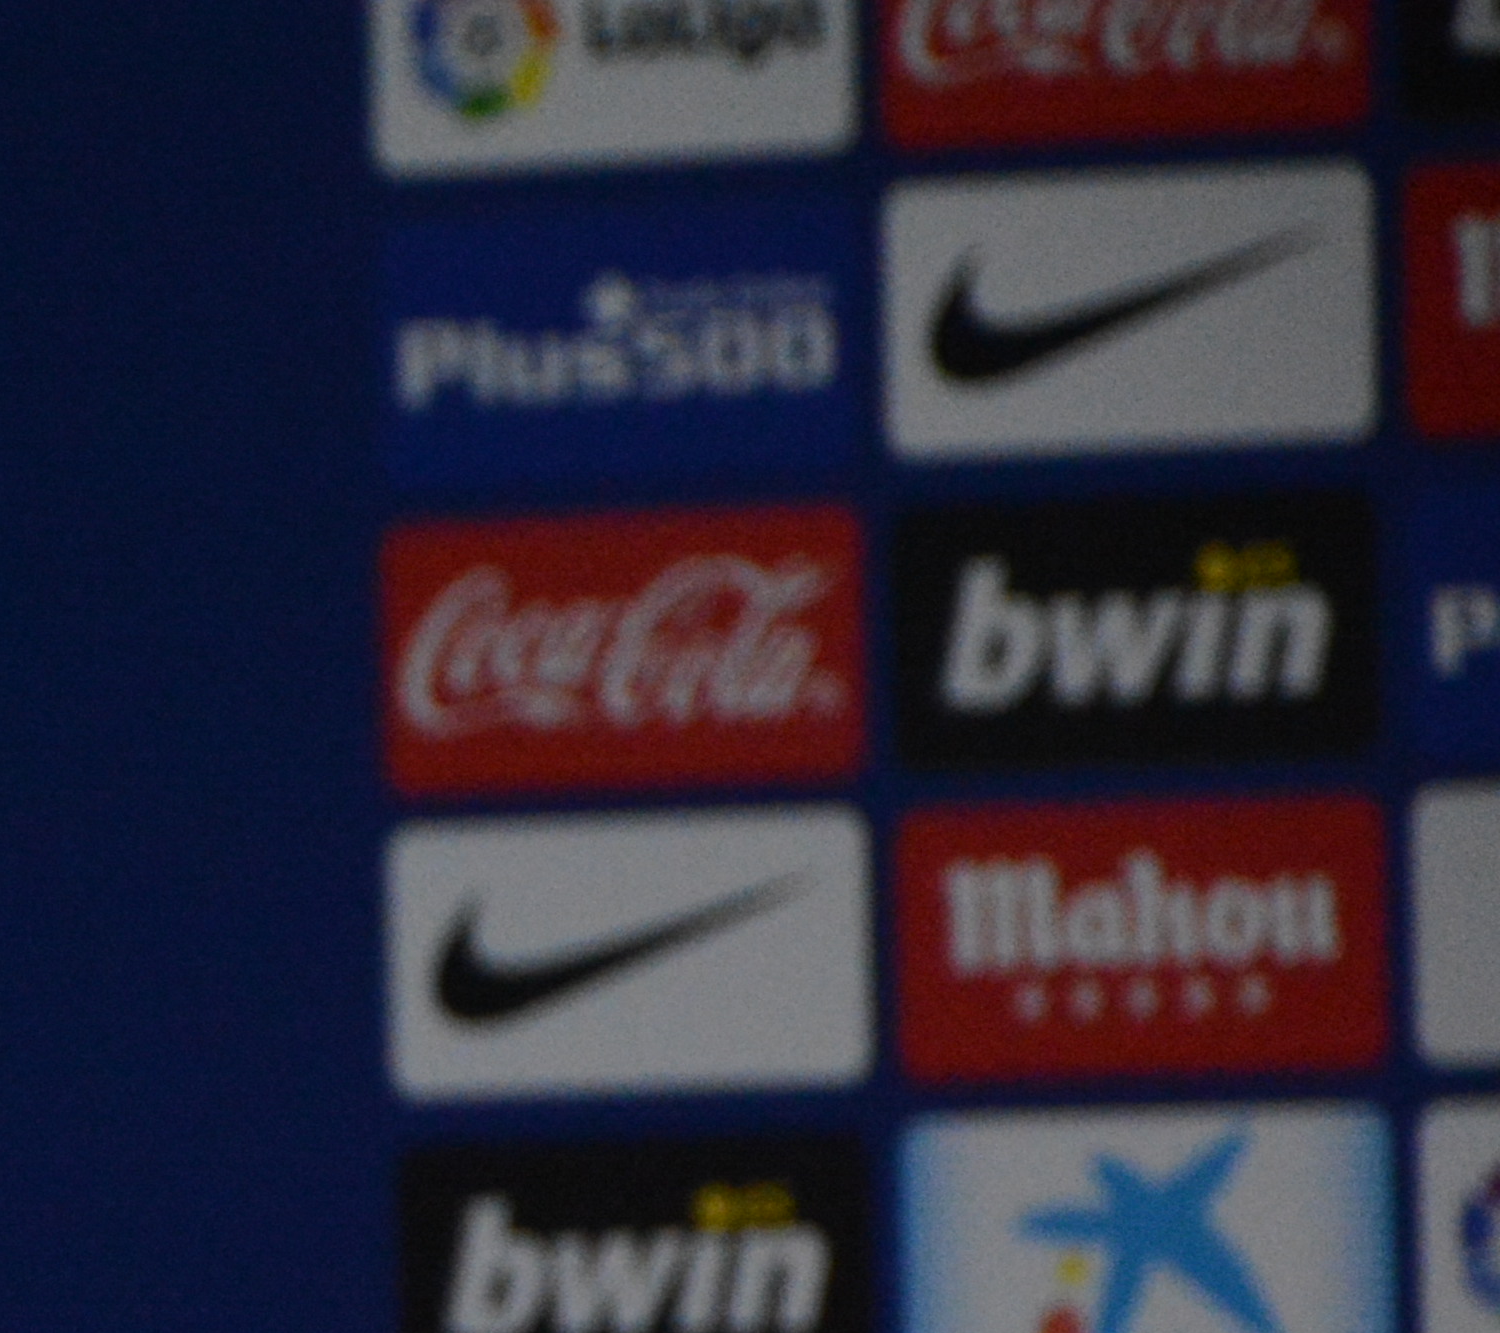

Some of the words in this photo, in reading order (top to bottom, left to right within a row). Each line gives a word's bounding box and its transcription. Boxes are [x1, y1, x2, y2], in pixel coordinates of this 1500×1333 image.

[400, 553, 830, 738] Coca-Cola
[942, 557, 1327, 710] bwin
[946, 851, 1338, 975] Mahou
